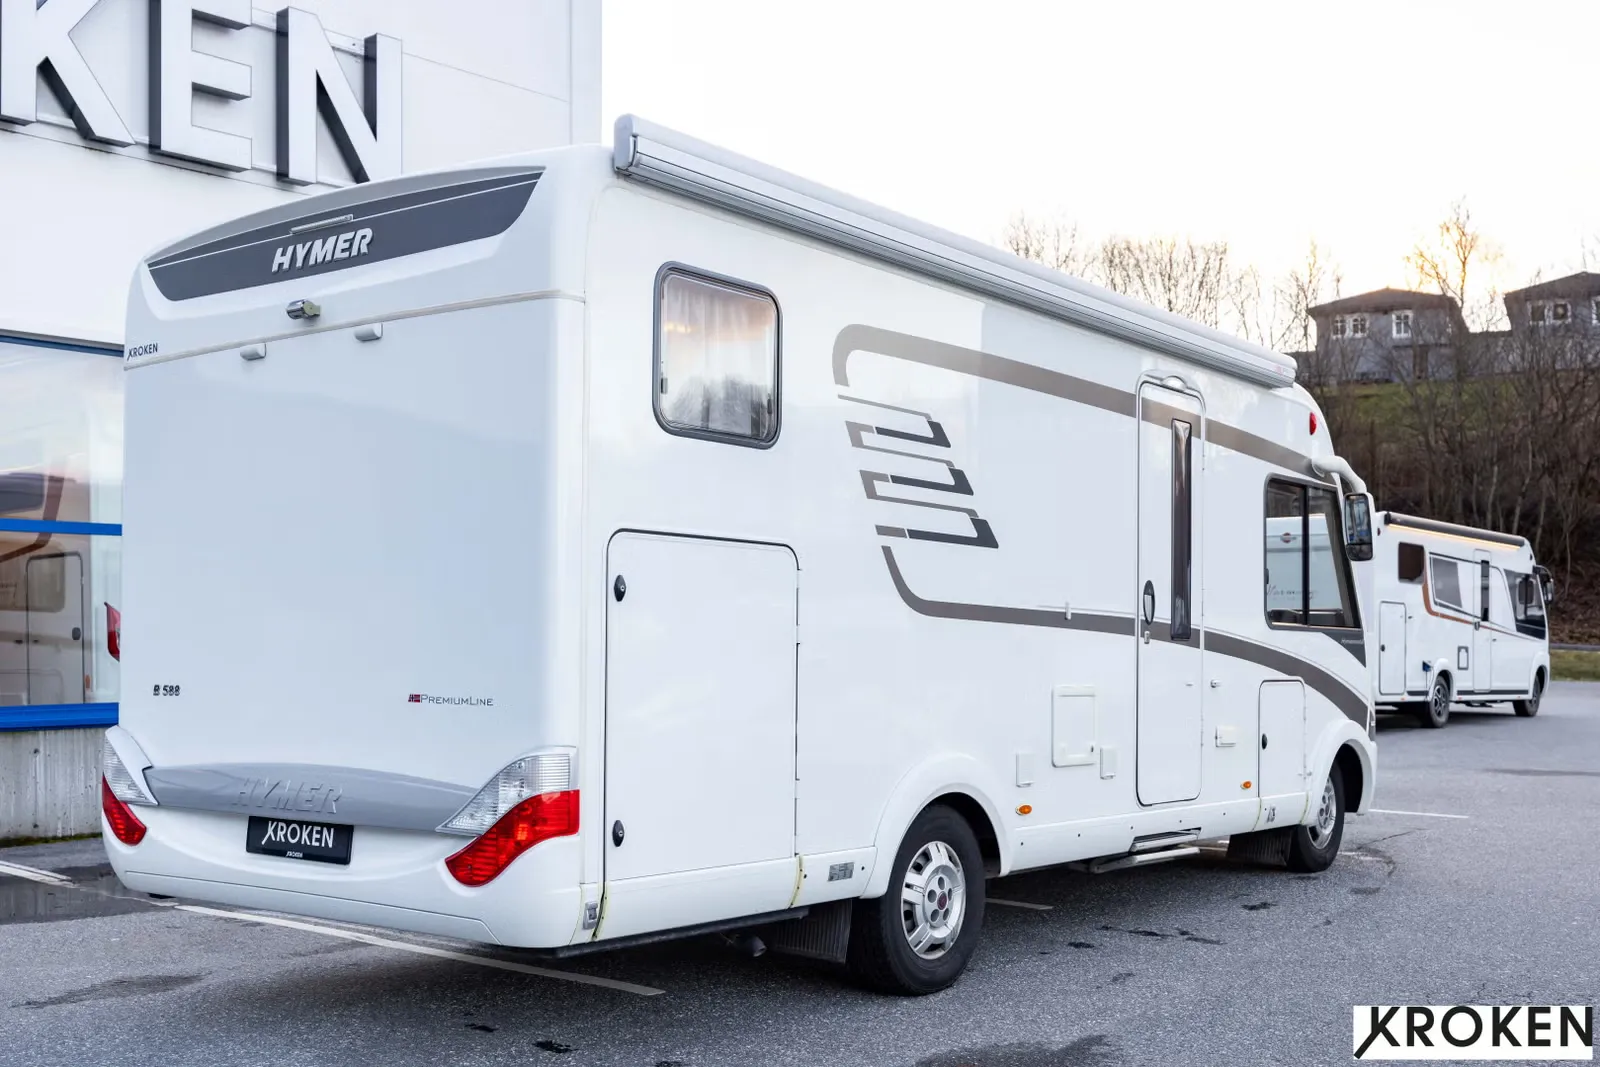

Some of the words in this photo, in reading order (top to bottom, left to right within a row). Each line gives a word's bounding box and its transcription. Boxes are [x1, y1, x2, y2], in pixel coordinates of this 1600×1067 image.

[272, 228, 373, 273] HYMER
[153, 684, 160, 696] B
[162, 684, 180, 696] 588
[231, 777, 343, 814] HYMER
